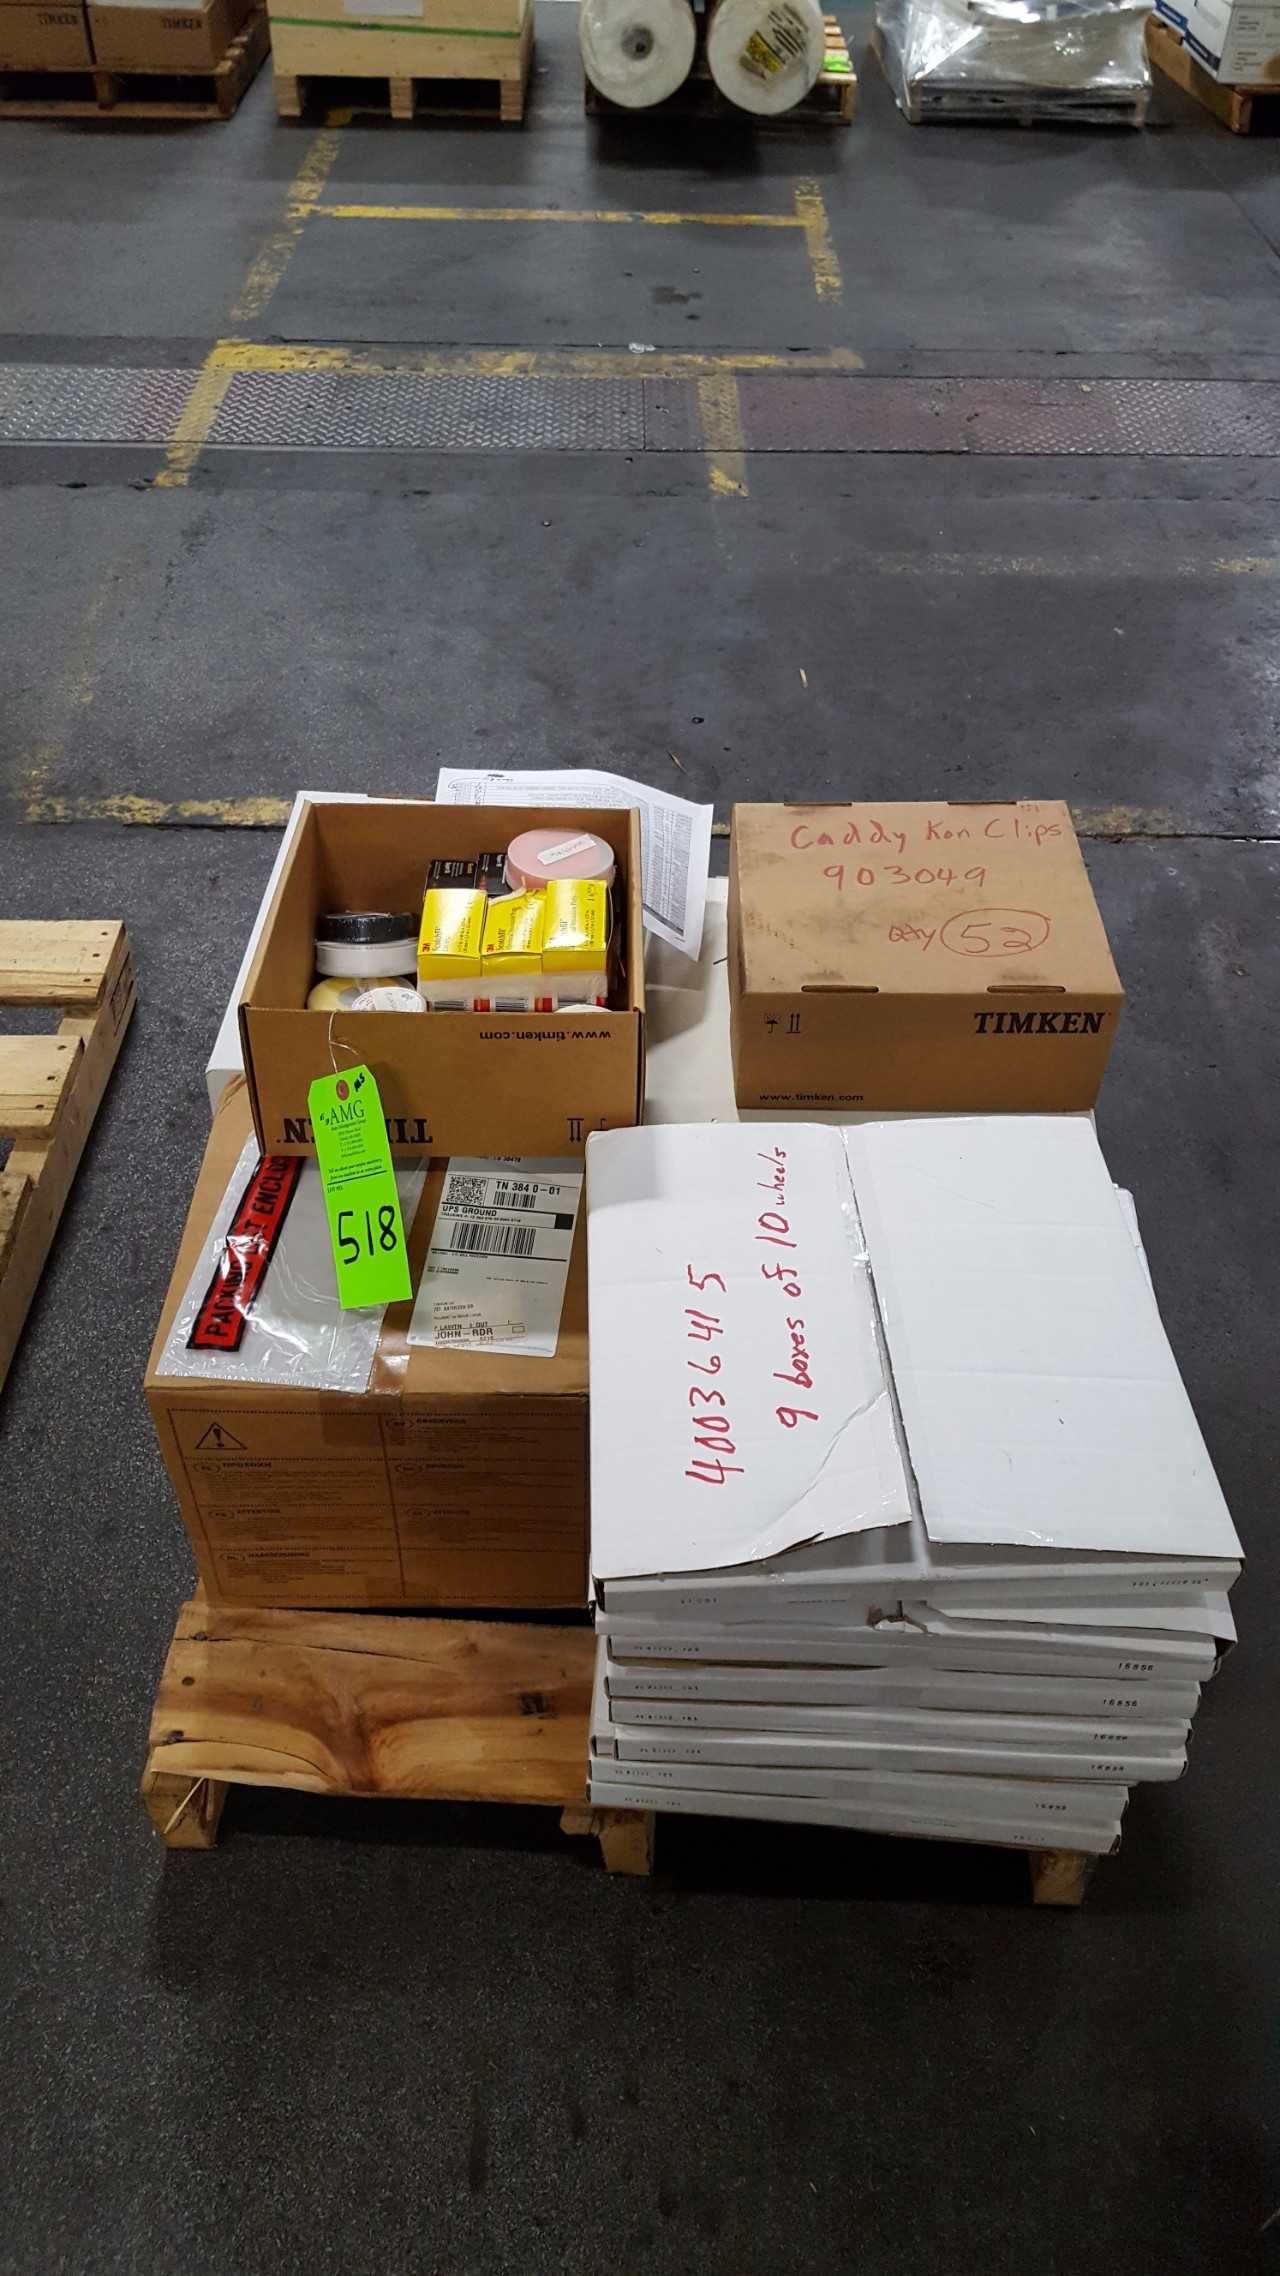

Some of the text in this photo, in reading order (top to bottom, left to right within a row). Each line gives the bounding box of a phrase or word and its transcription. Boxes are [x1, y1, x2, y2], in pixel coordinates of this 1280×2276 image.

[790, 819, 908, 853] Caddy
[984, 817, 1063, 846] Clips
[823, 864, 987, 891] 903049
[958, 922, 1034, 954] 52
[480, 1030, 612, 1042] www.timken.com
[974, 1011, 1107, 1034] TIMKEN
[759, 1093, 865, 1102] www.timken.com
[329, 1099, 366, 1126] AMG
[495, 1180, 509, 1190] TN
[512, 1182, 529, 1192] 384
[442, 1205, 498, 1217] UPS GROUND
[338, 1205, 397, 1265] 518
[205, 1258, 253, 1338] PACKING
[754, 1146, 819, 1429] 9 boxes of 10 wheels
[434, 1328, 462, 1340] JOHN
[472, 1327, 494, 1337] RDR
